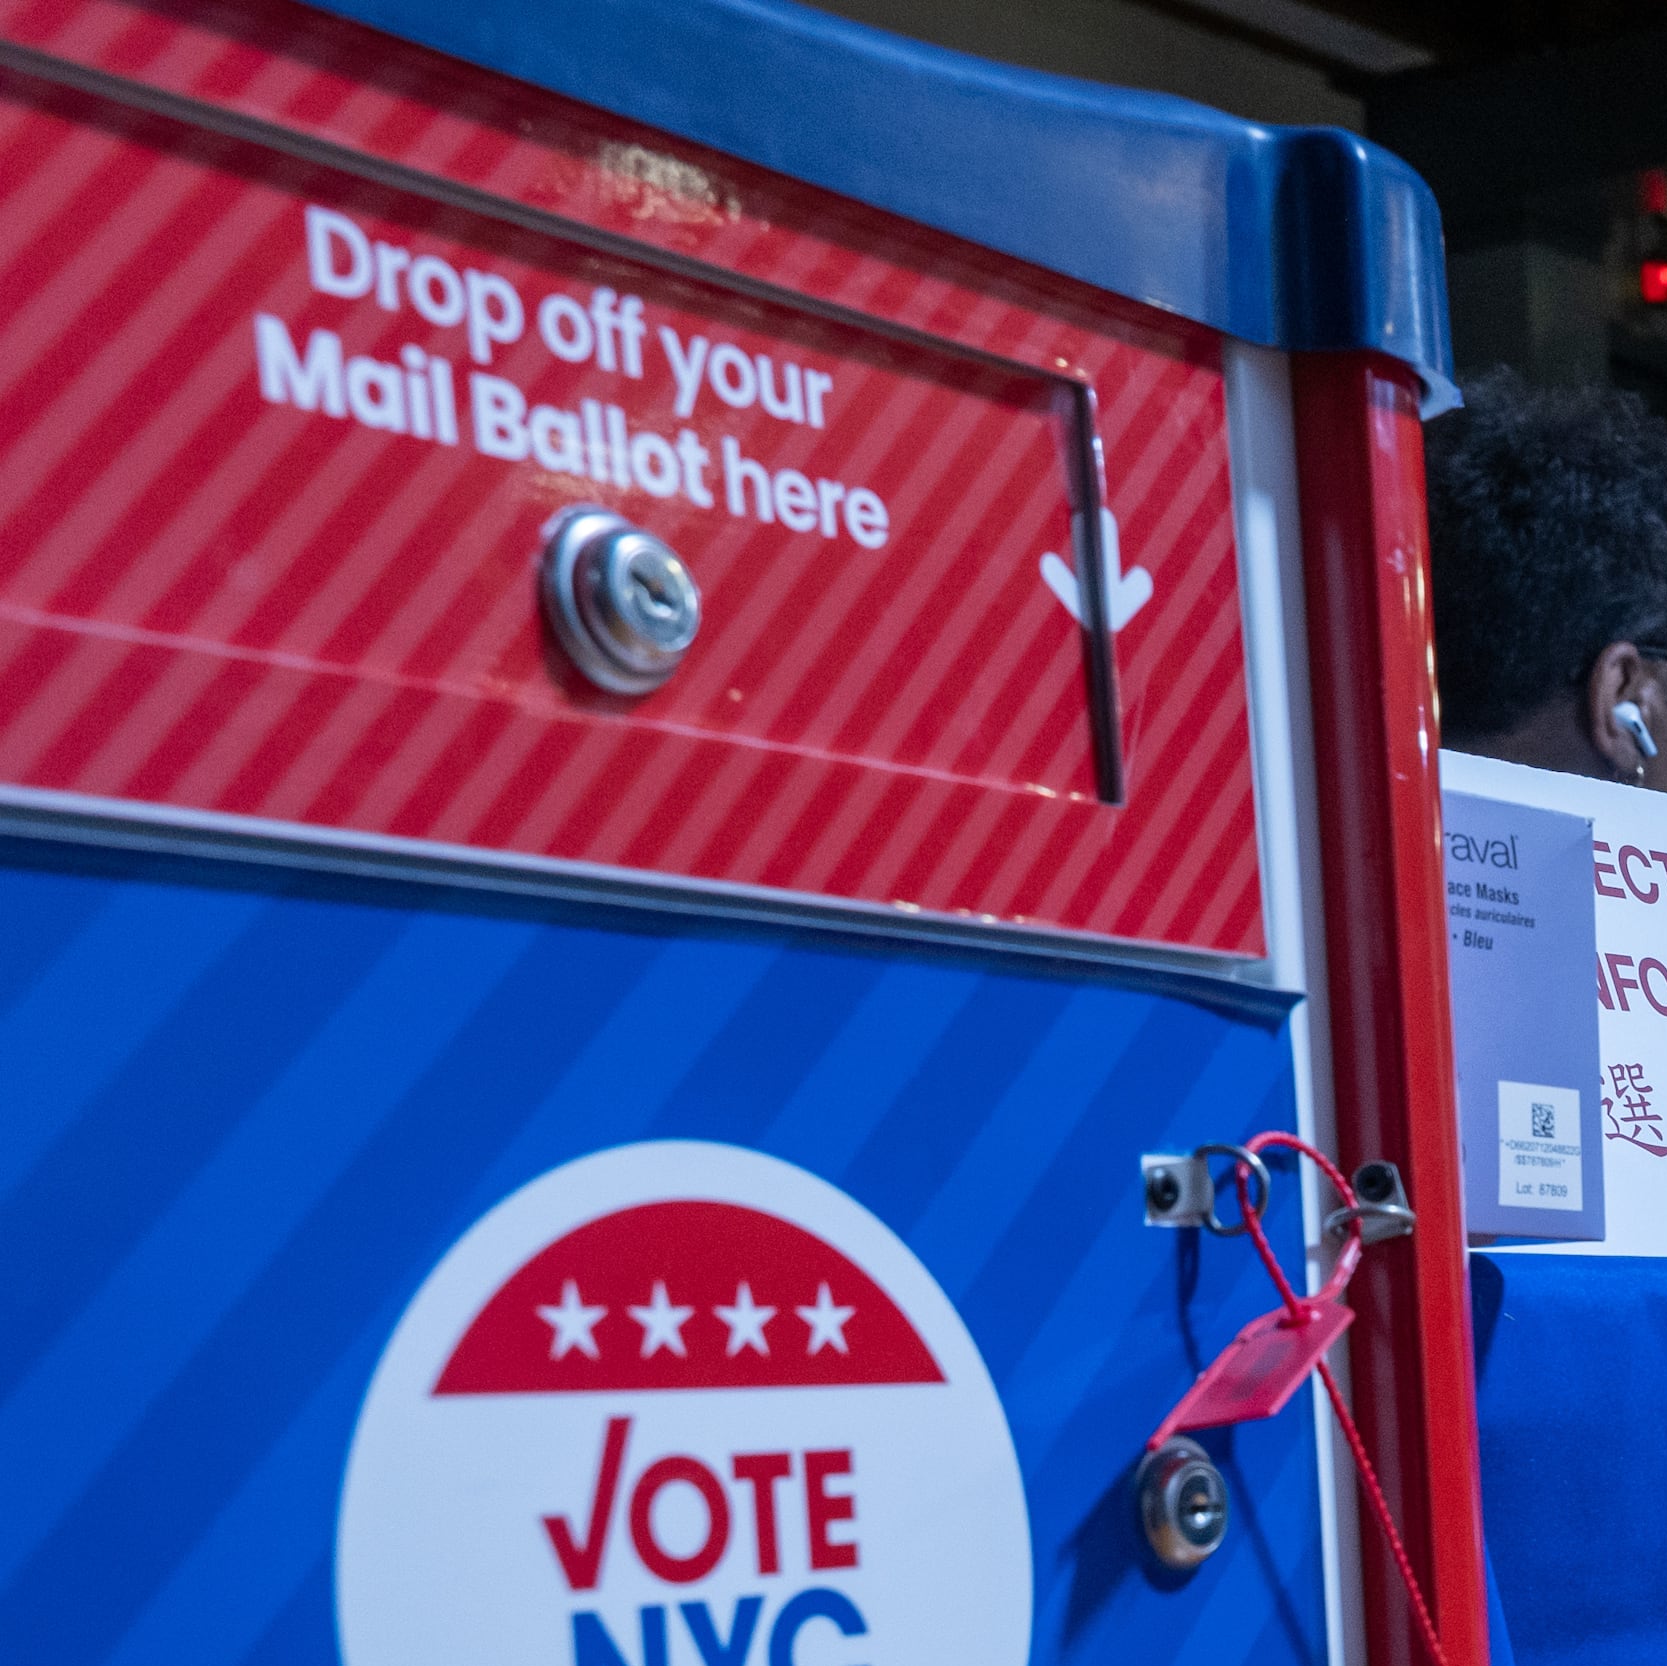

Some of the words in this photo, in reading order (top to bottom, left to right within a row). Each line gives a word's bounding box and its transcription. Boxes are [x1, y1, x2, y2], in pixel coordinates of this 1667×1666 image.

[305, 206, 524, 364] Drop
[538, 286, 646, 378] off
[658, 326, 833, 429] your
[255, 313, 457, 446] Mail
[470, 372, 713, 508] Ballot
[722, 436, 889, 549] here
[1463, 930, 1493, 950] Bleu
[1476, 883, 1519, 905] Masks
[542, 1415, 860, 1592] VOTE
